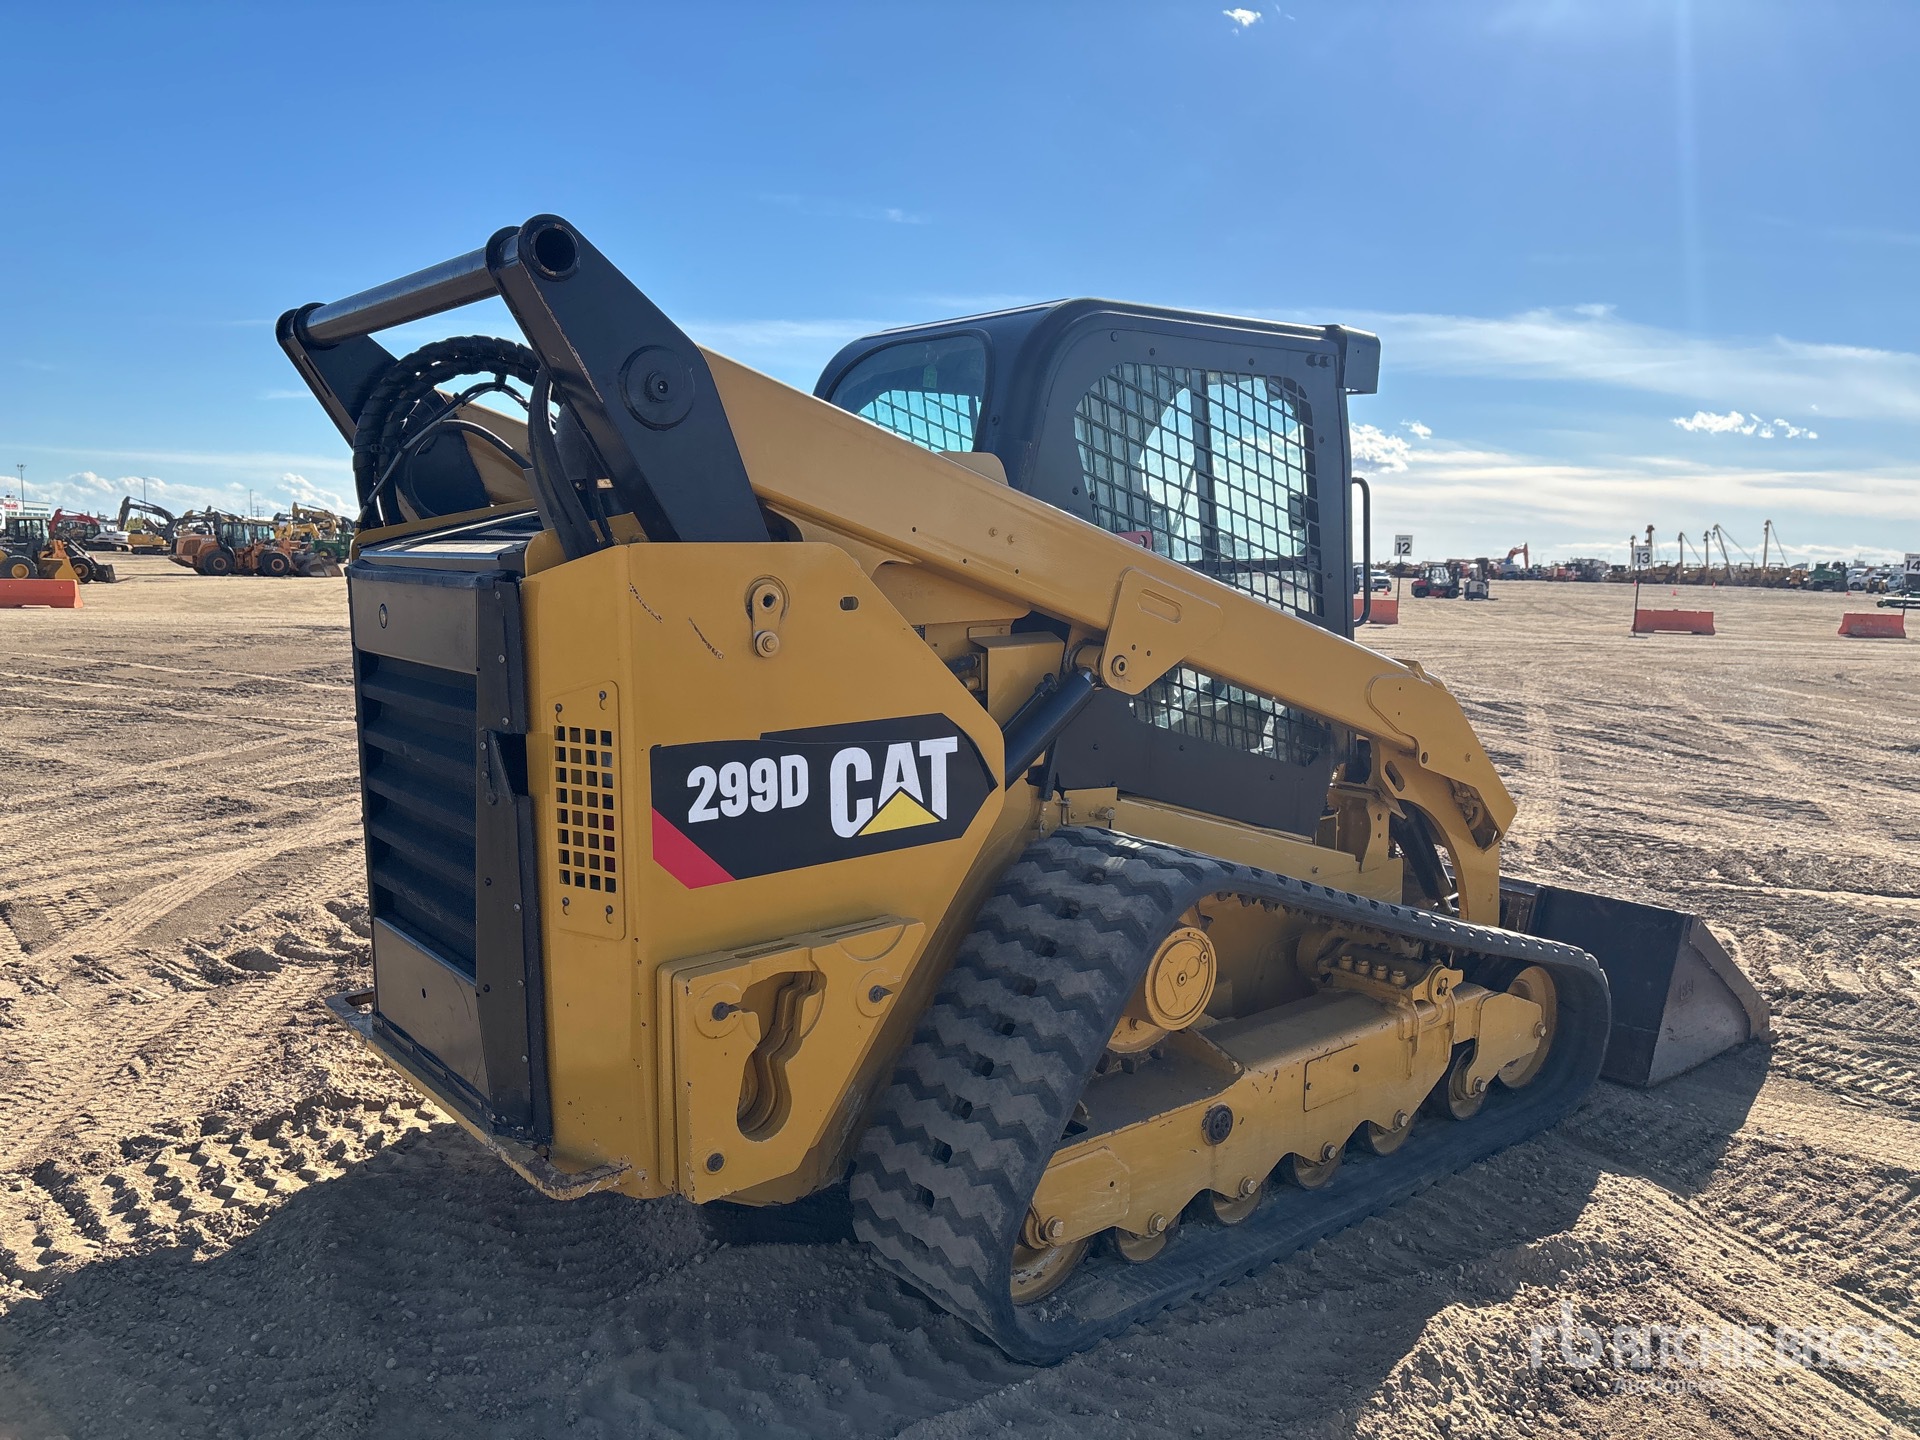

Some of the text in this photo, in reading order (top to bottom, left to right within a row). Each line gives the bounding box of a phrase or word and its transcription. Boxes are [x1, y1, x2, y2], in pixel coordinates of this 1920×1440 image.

[1396, 542, 1410, 554] 12
[1636, 552, 1650, 564] 13
[1906, 560, 1920, 571] 14
[686, 736, 958, 838] 299D CAT
